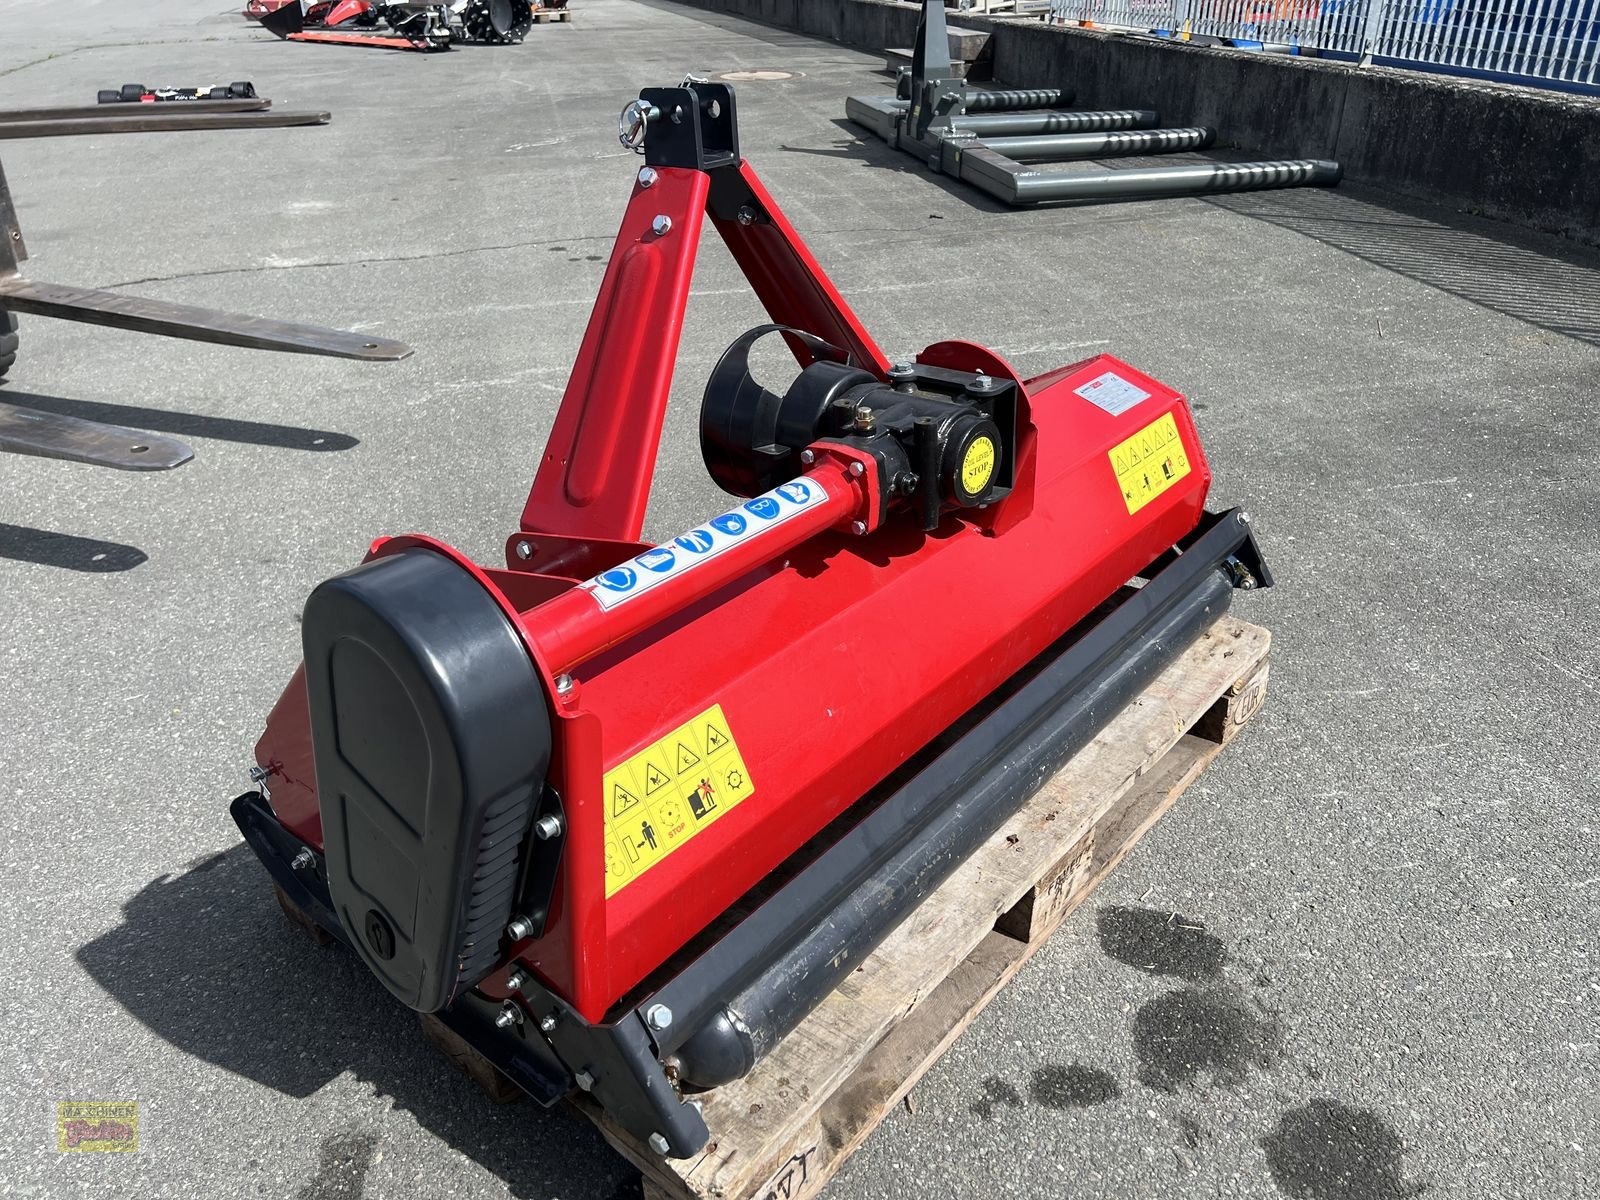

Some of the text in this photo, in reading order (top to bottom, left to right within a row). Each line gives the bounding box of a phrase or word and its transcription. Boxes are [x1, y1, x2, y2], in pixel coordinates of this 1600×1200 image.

[976, 451, 990, 462] LEVEL
[968, 461, 989, 478] STOP
[1241, 685, 1260, 719] EUR
[668, 822, 685, 839] STOP
